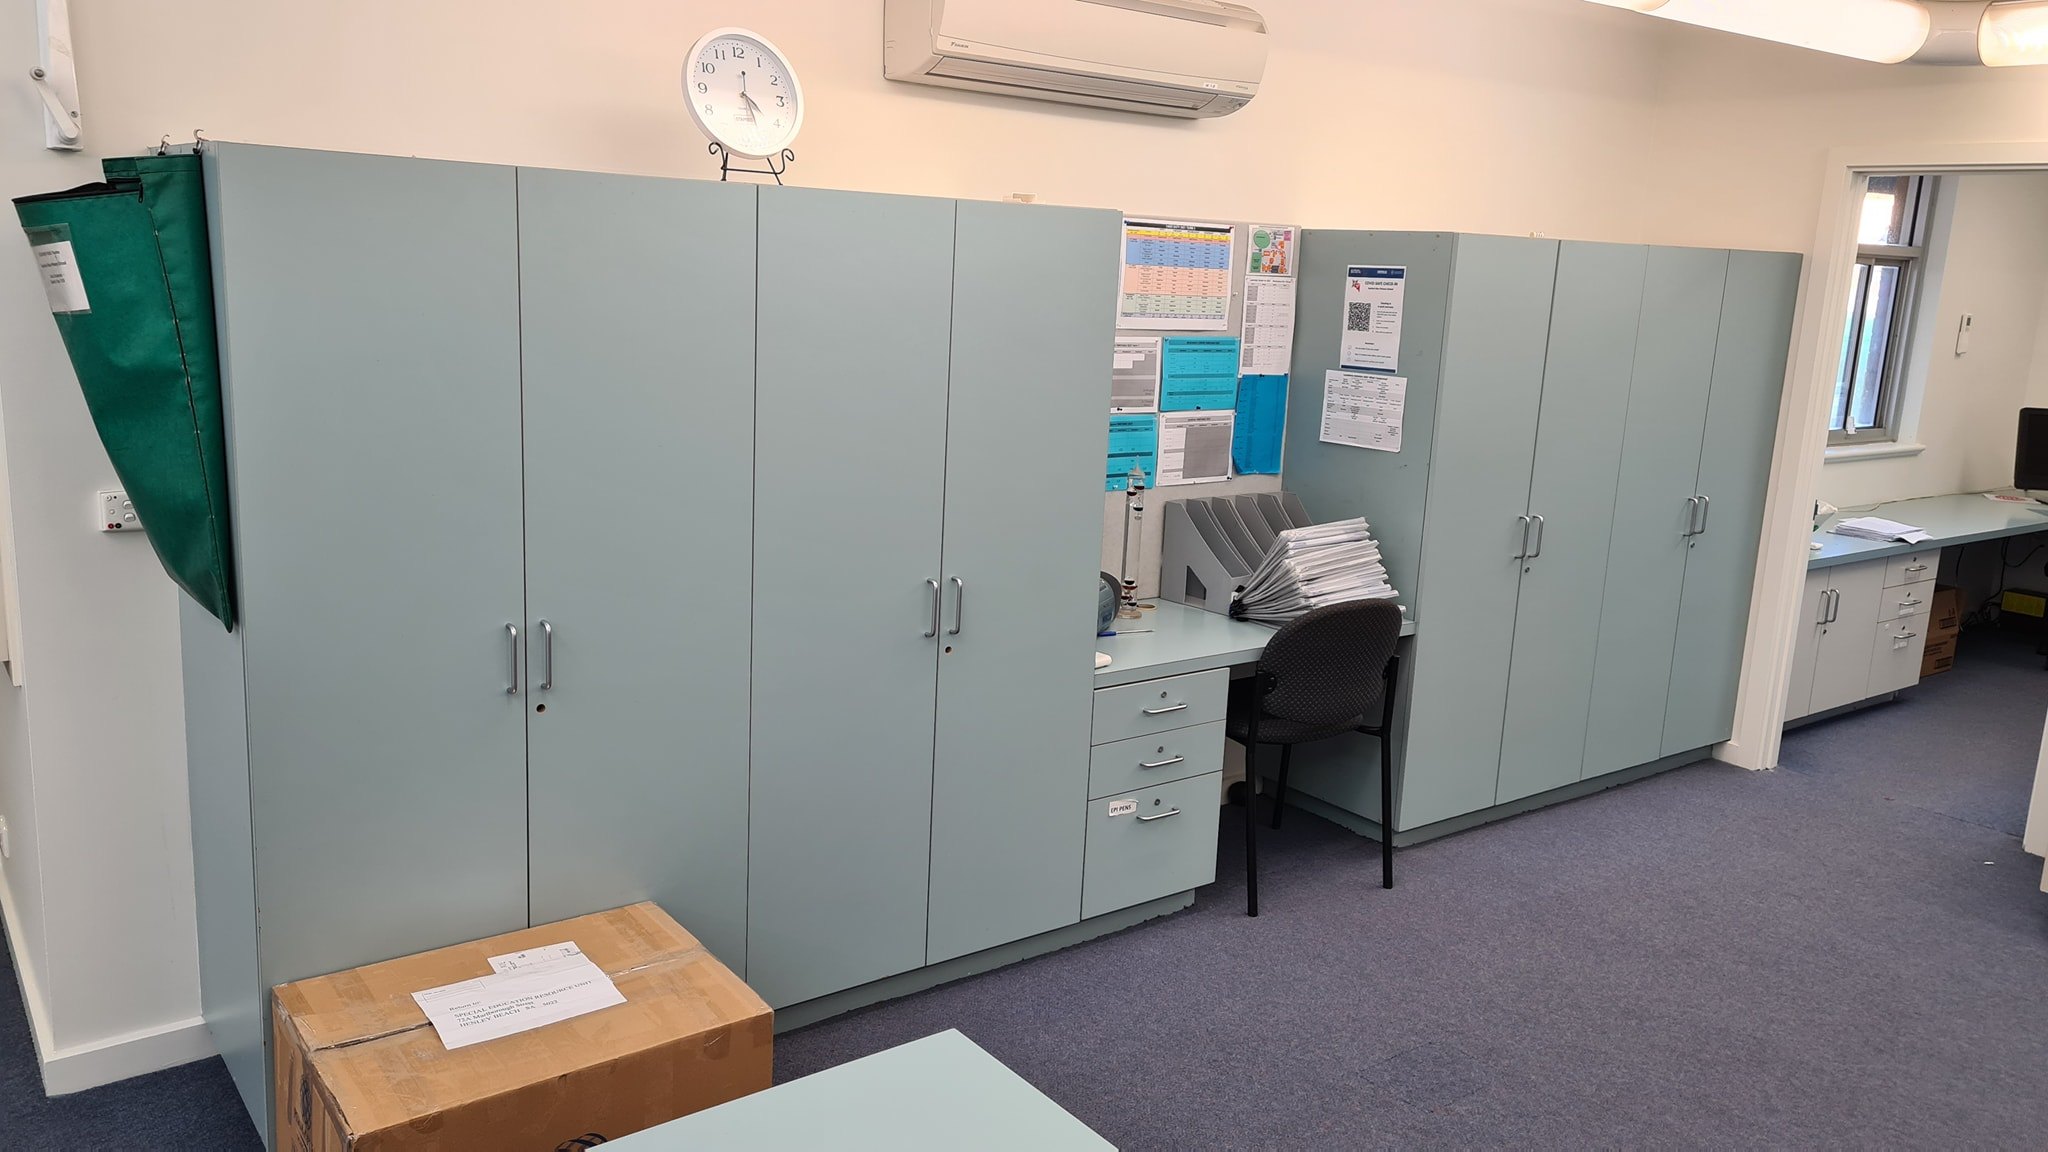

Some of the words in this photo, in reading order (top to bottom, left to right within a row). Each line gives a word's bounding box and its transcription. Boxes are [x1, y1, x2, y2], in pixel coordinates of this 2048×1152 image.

[714, 48, 726, 61] 11
[732, 46, 745, 59] 12
[701, 62, 715, 74] 10
[756, 57, 761, 68] 1
[769, 74, 778, 86] 2
[697, 81, 708, 94] 9
[775, 95, 785, 108] 3
[704, 104, 714, 116] 8
[773, 119, 781, 128] 4
[1119, 804, 1132, 812] PENS
[454, 1008, 487, 1018] SPECIAL
[488, 996, 534, 1010] EDUCATION
[534, 983, 573, 999] RESOURCE
[573, 980, 592, 988] UNIT
[449, 1003, 472, 1011] Return
[473, 1005, 515, 1019] Marlborough
[459, 1017, 492, 1028] HENLEY
[493, 1009, 521, 1019] BEACH
